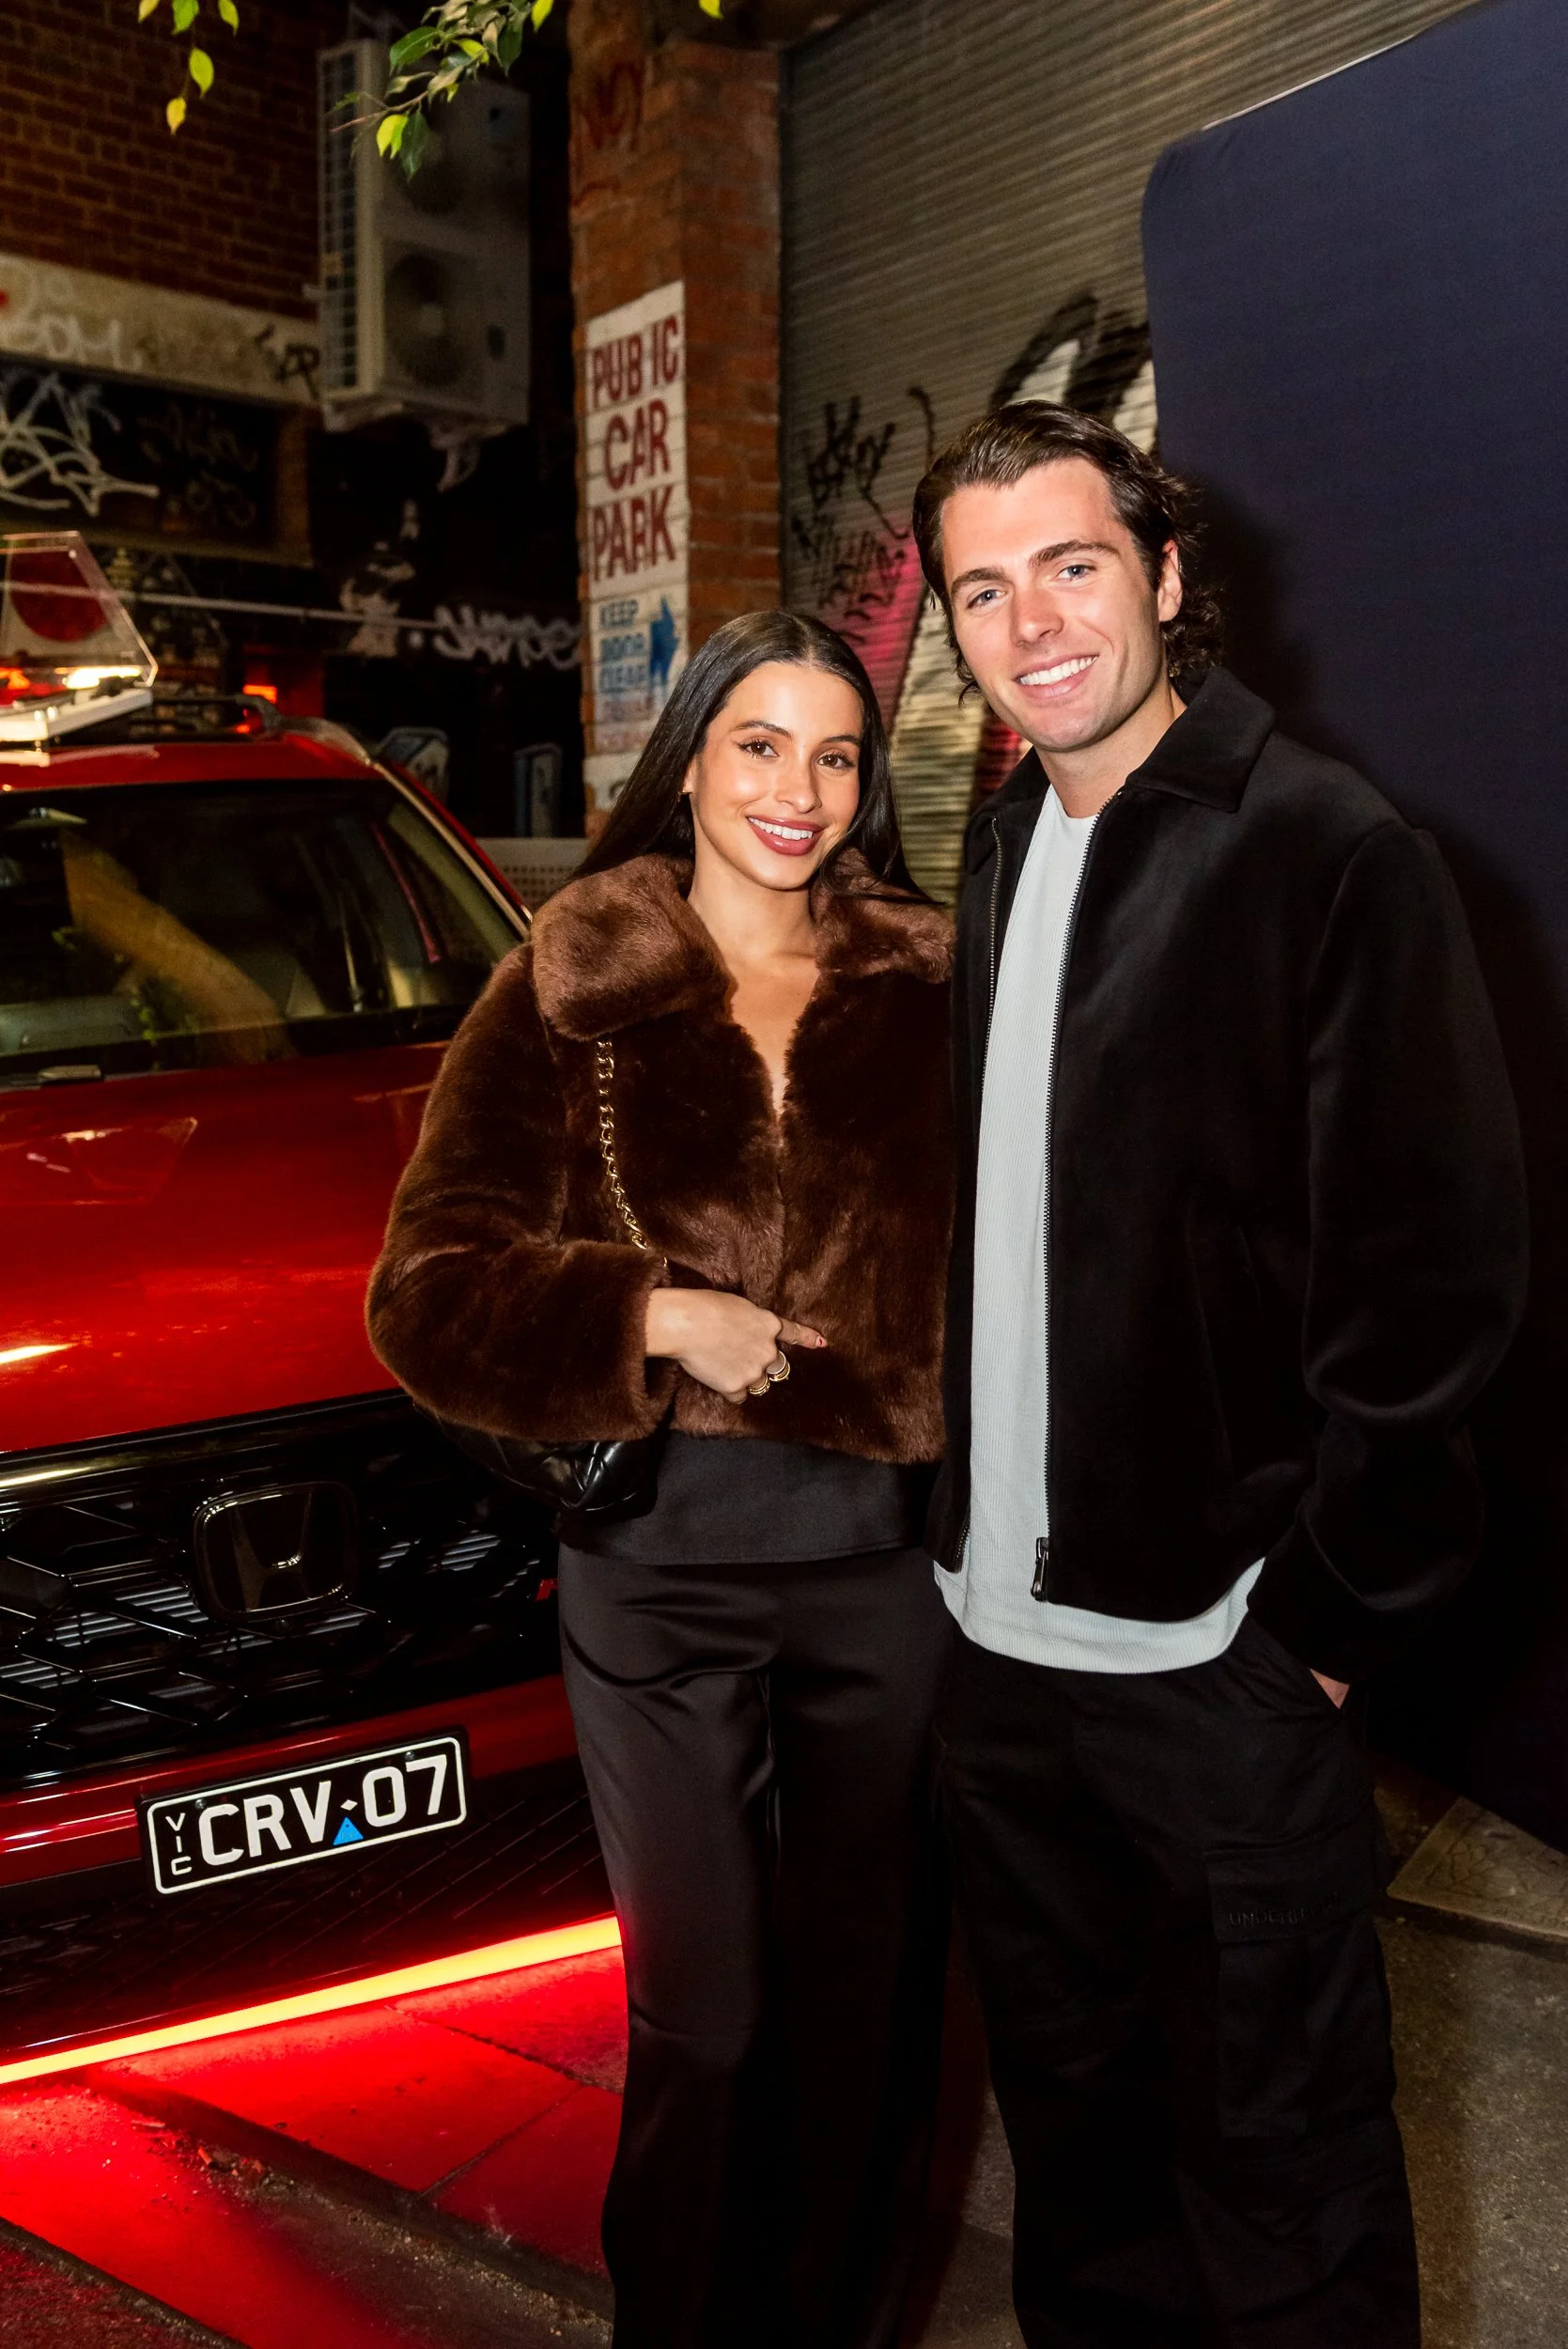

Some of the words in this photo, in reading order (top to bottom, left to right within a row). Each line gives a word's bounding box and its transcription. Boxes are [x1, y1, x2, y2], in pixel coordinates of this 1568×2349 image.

[593, 314, 677, 409] PUBIC
[605, 398, 670, 490] CAR
[593, 485, 676, 580] PARK
[600, 599, 639, 629] KEEP
[165, 1812, 193, 1875] VIC
